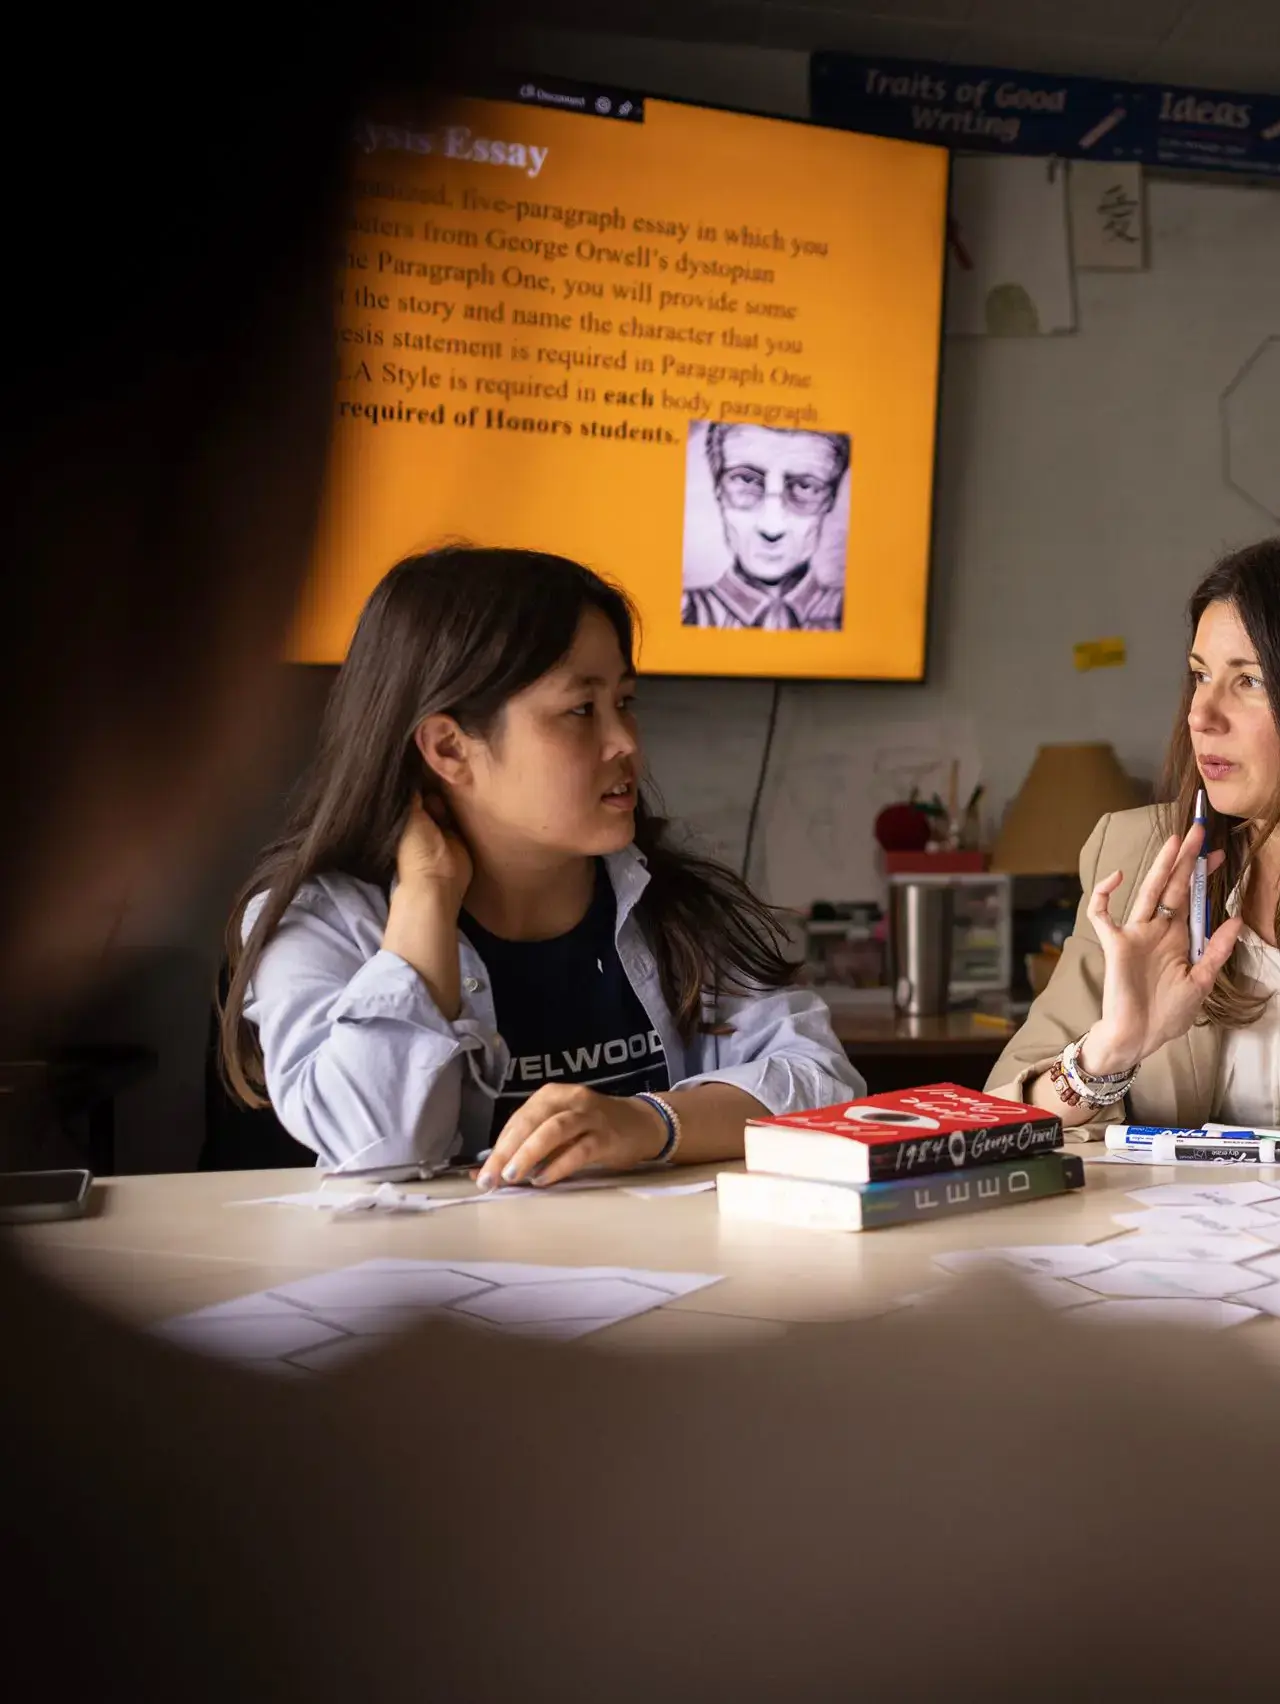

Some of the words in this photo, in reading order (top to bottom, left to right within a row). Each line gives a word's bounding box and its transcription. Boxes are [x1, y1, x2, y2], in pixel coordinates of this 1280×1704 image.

[864, 67, 947, 101] Traits
[955, 78, 986, 108] of
[994, 82, 1068, 114] Good
[1158, 91, 1253, 129] Ideas
[910, 104, 1022, 144] Writing
[443, 125, 549, 179] Essay
[423, 220, 479, 248] from
[485, 228, 569, 262] George
[575, 239, 669, 270] Orwell's
[675, 251, 775, 285] dystopian
[632, 215, 690, 243] essay
[697, 218, 717, 243] in
[723, 225, 785, 252] which
[790, 237, 829, 258] you
[378, 250, 496, 290] Paragraph
[501, 265, 556, 295] One,
[563, 277, 604, 301] you
[612, 281, 652, 305] will
[659, 287, 739, 312] provide
[745, 298, 798, 319] some
[355, 286, 390, 311] the
[397, 294, 456, 324] story
[462, 300, 505, 324] and
[511, 308, 573, 330] name
[579, 311, 613, 334] the
[618, 316, 716, 346] character
[721, 326, 759, 349] that
[764, 337, 803, 357] you
[392, 330, 503, 360] statement
[510, 337, 530, 362] is
[536, 345, 627, 372] required
[634, 352, 654, 373] in
[661, 353, 764, 387] Paragraph
[381, 361, 442, 393] Style
[449, 367, 468, 391] is
[474, 374, 569, 403] required
[576, 379, 596, 404] in
[603, 386, 655, 408] each
[660, 387, 711, 417] body
[339, 399, 445, 425] required
[453, 405, 480, 428] of
[485, 406, 573, 436] Honors
[579, 420, 680, 445] students.
[895, 1138, 945, 1171] 1984
[971, 1129, 1015, 1159] George
[1017, 1122, 1059, 1150] Orwell
[914, 1170, 1031, 1210] FEED
